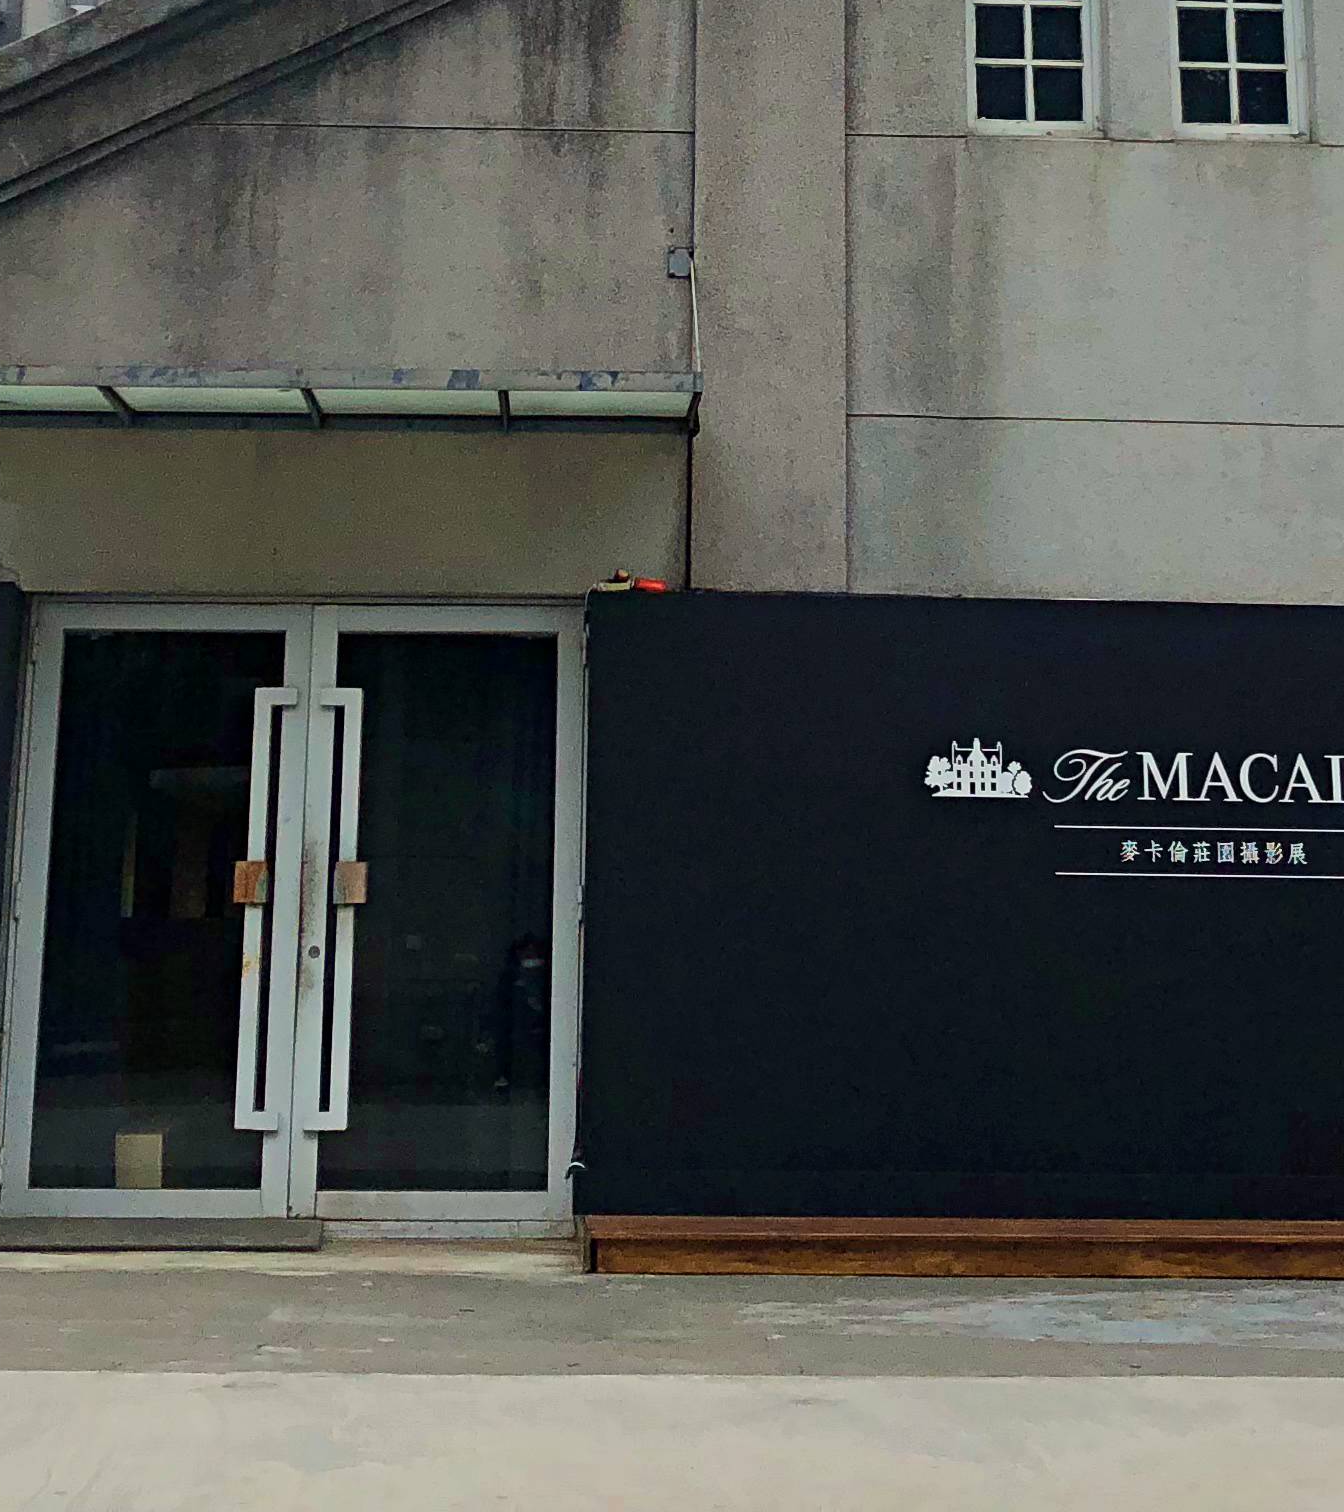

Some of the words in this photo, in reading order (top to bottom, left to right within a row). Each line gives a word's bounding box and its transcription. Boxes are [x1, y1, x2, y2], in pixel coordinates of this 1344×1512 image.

[1042, 748, 1130, 803] The
[1119, 839, 1308, 865] 麥卡倫莊園攝影展
